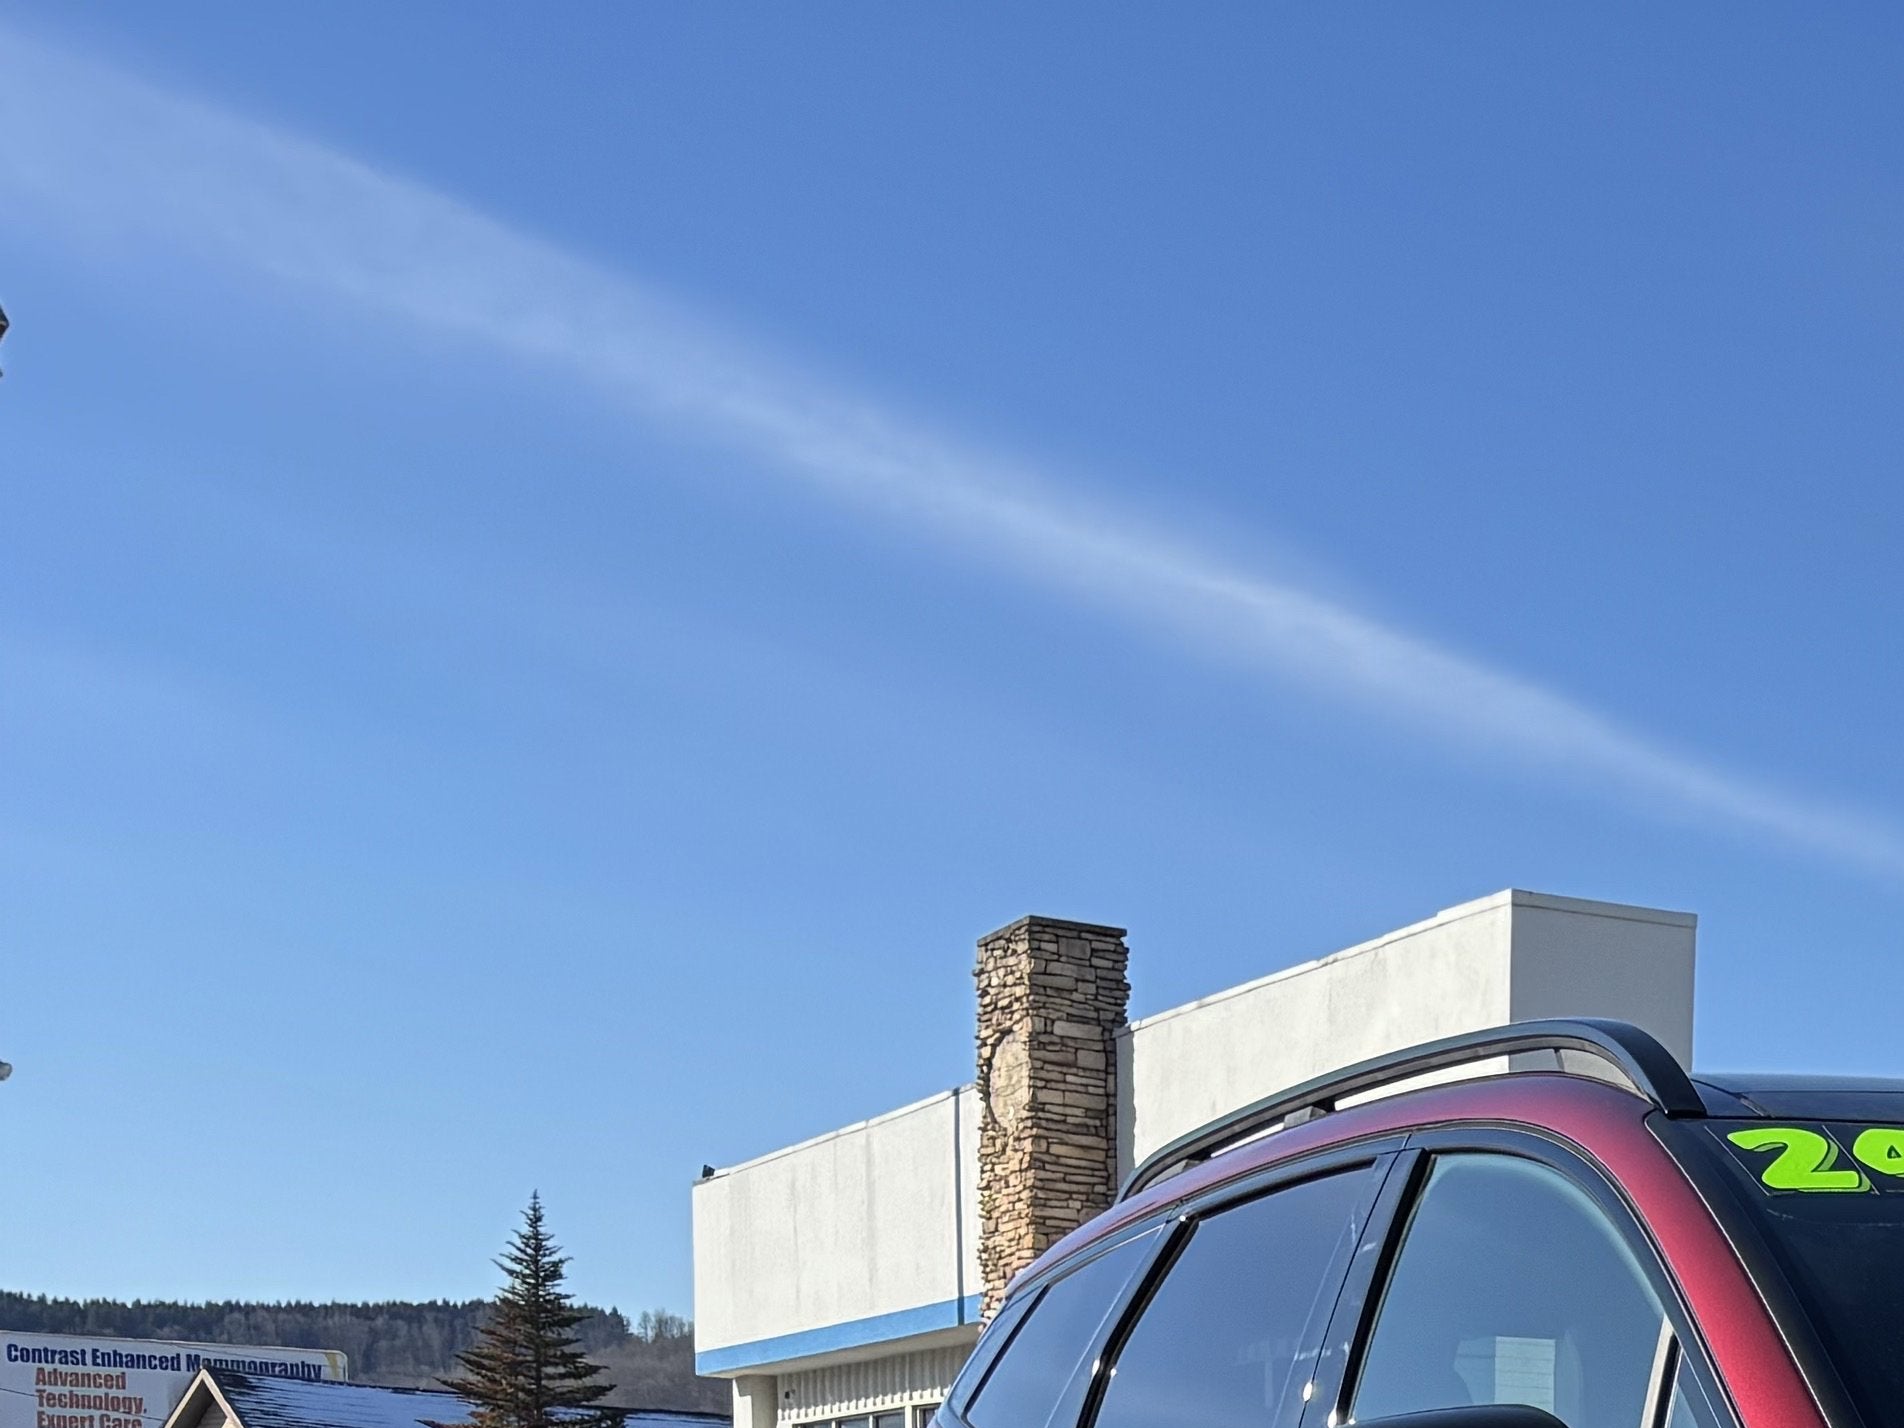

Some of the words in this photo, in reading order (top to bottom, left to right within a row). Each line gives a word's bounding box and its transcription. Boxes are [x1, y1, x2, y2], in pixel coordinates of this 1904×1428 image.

[7, 1343, 87, 1367] Contrast
[91, 1348, 182, 1372] Enhanced
[36, 1367, 126, 1390] Advanced
